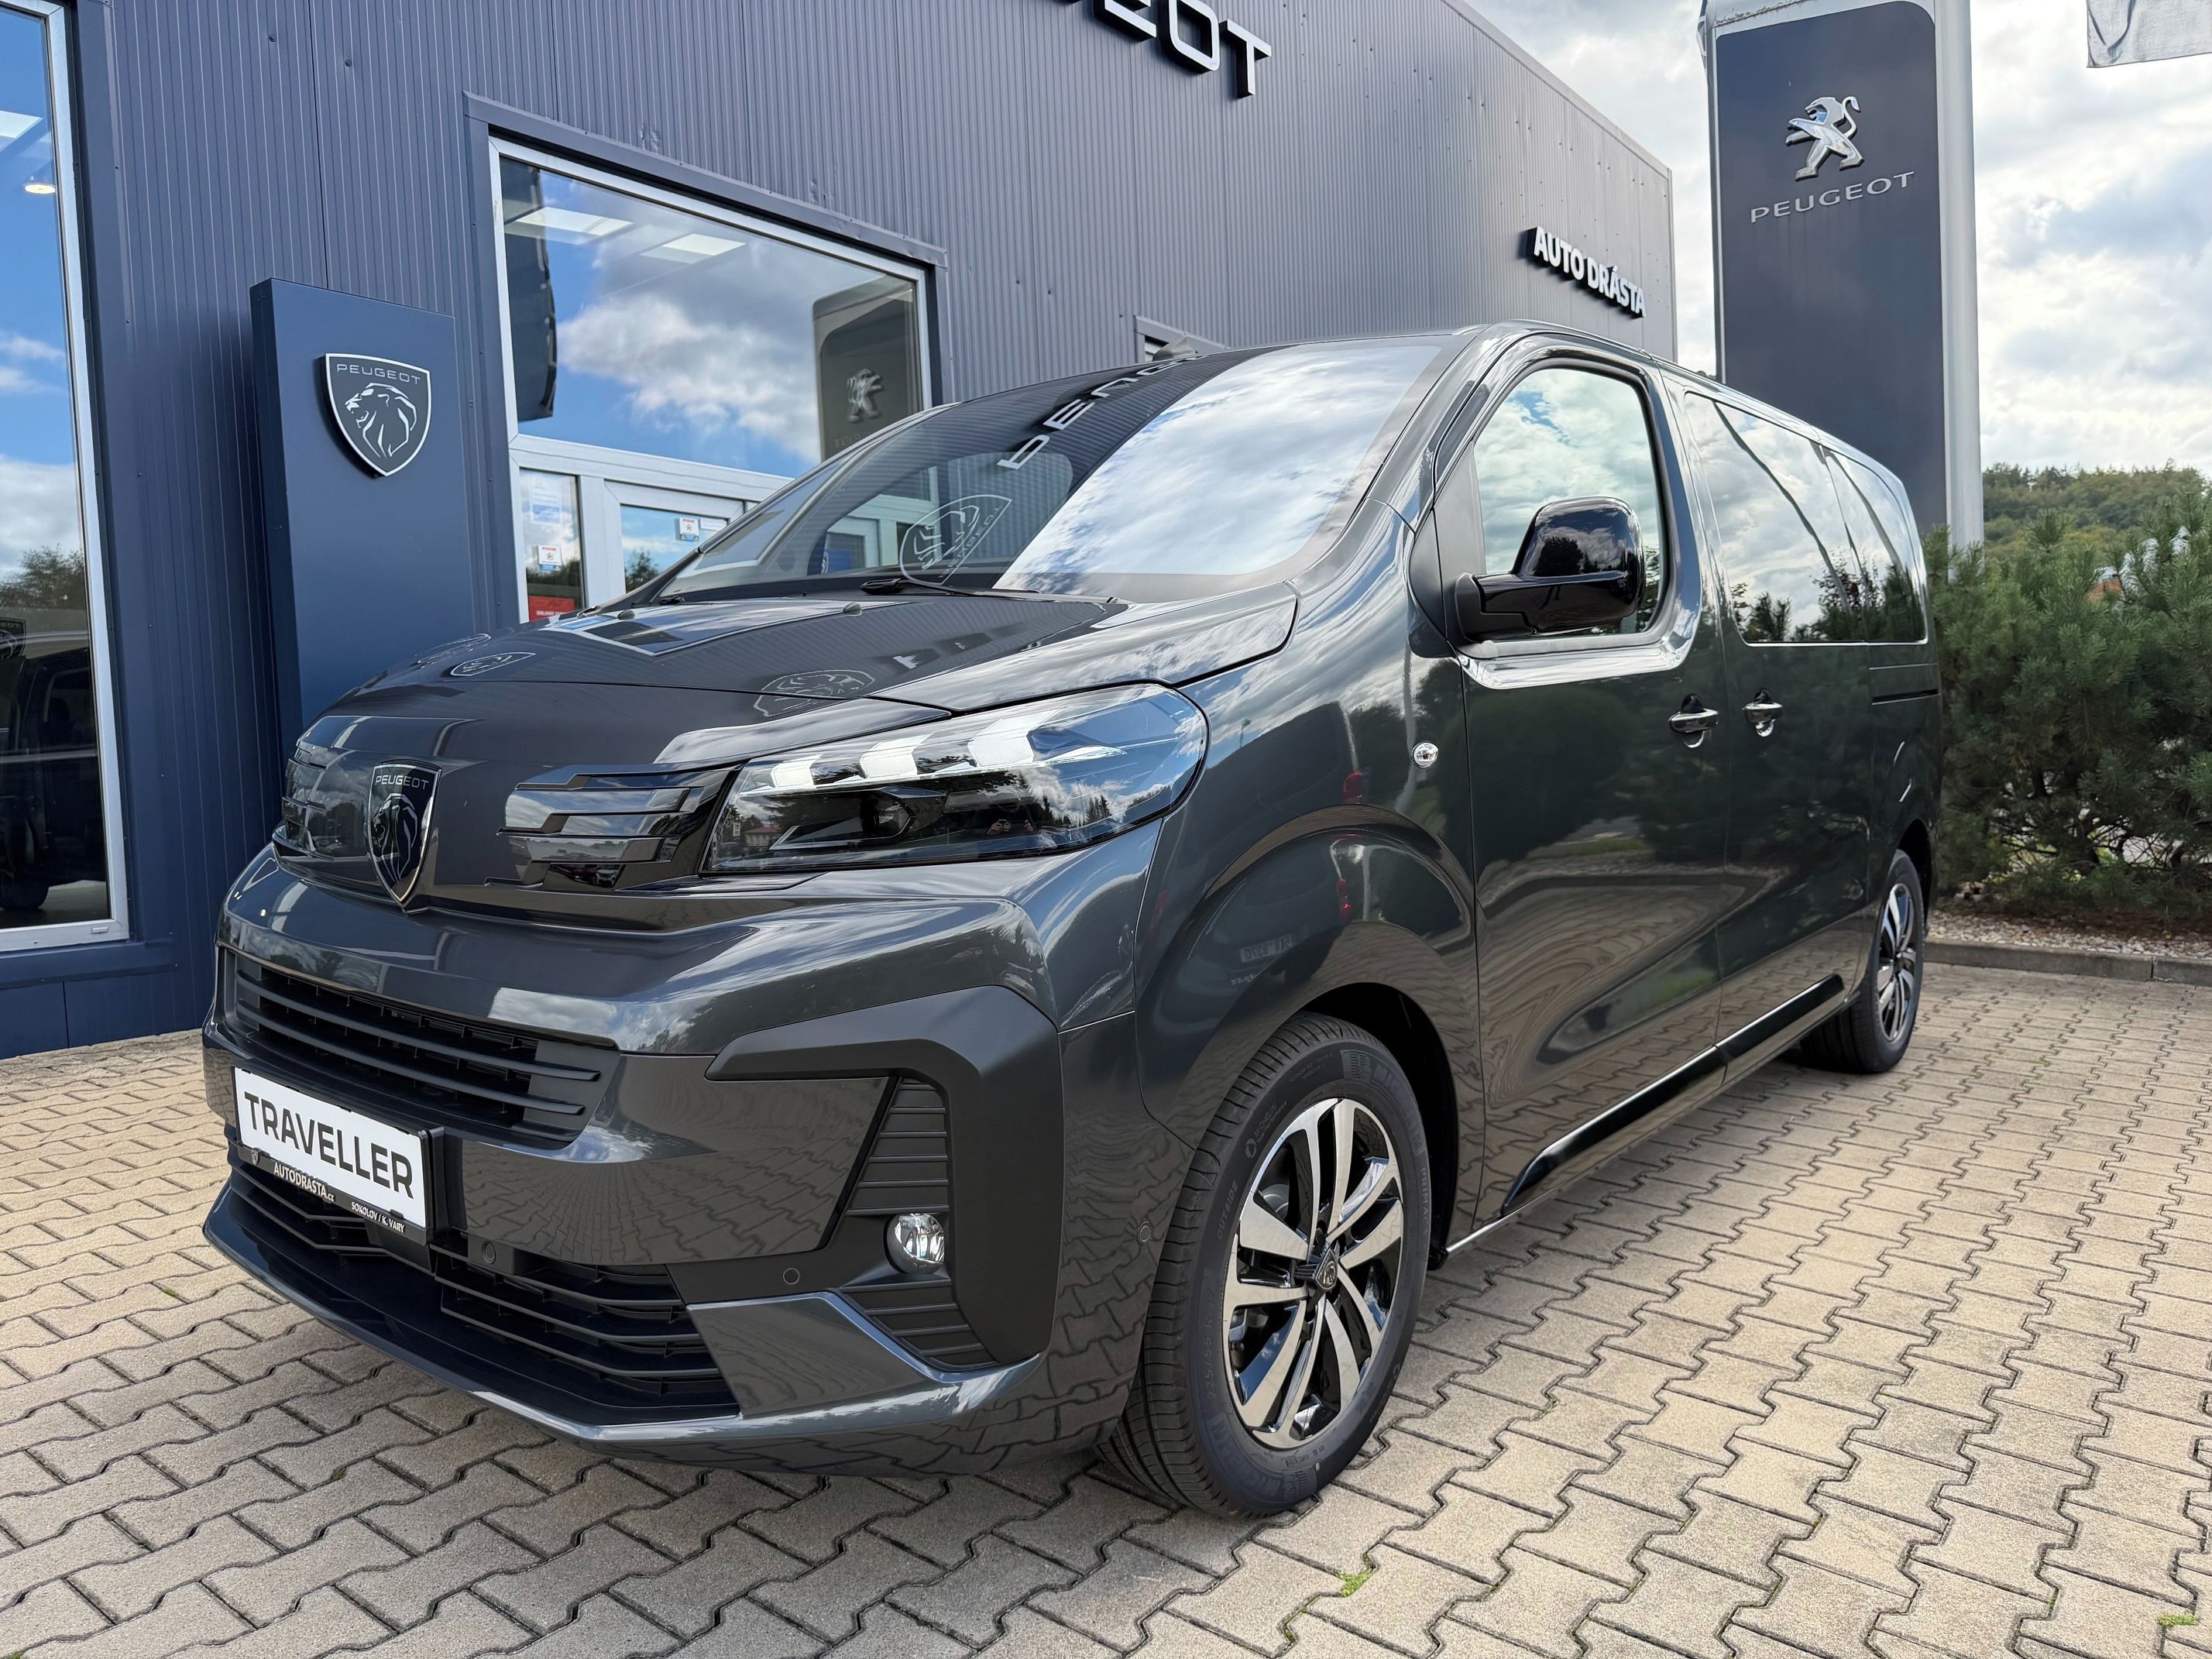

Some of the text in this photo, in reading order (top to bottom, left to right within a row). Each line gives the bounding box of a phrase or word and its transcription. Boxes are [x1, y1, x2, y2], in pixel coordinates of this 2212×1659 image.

[1750, 171, 1915, 223] PEUGEOT
[1534, 225, 1647, 318] AUTO DRÁSTA
[336, 363, 421, 385] PEUGEOT
[375, 775, 429, 790] PEUGEOT
[244, 1091, 414, 1200] TRAVELLER
[273, 1162, 335, 1202] AUTODRASTA.cz
[351, 1201, 379, 1221] SOKOLOV
[389, 1218, 406, 1234] VARY
[1216, 1179, 1238, 1240] OUTSIDE
